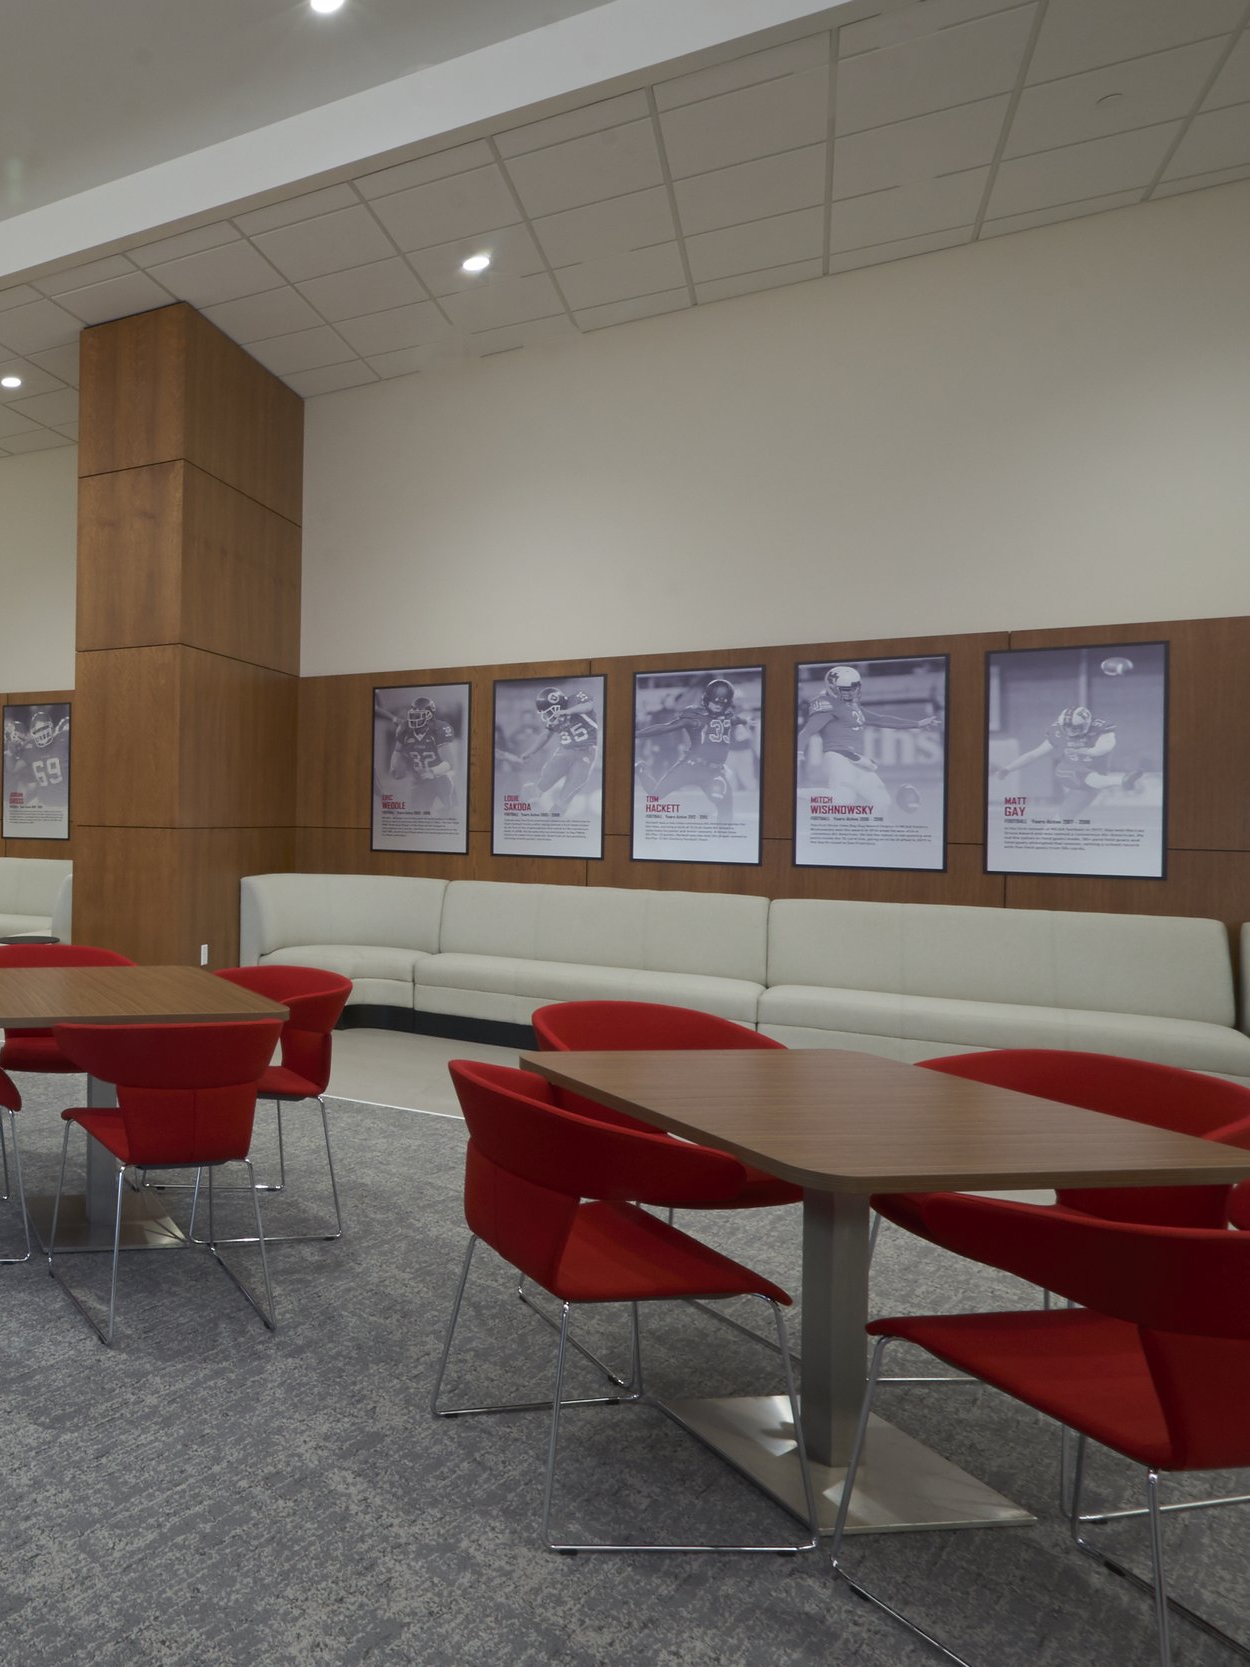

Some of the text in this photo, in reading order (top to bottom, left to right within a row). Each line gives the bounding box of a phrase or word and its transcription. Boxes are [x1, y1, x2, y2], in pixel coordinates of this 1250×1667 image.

[32, 758, 63, 786] 69
[645, 795, 659, 803] TOM
[810, 796, 833, 804] MITCH
[1004, 796, 1027, 805] MATT
[645, 804, 681, 813] HACKETT
[810, 805, 874, 815] WISHNOWSKY
[1004, 806, 1026, 817] GAY
